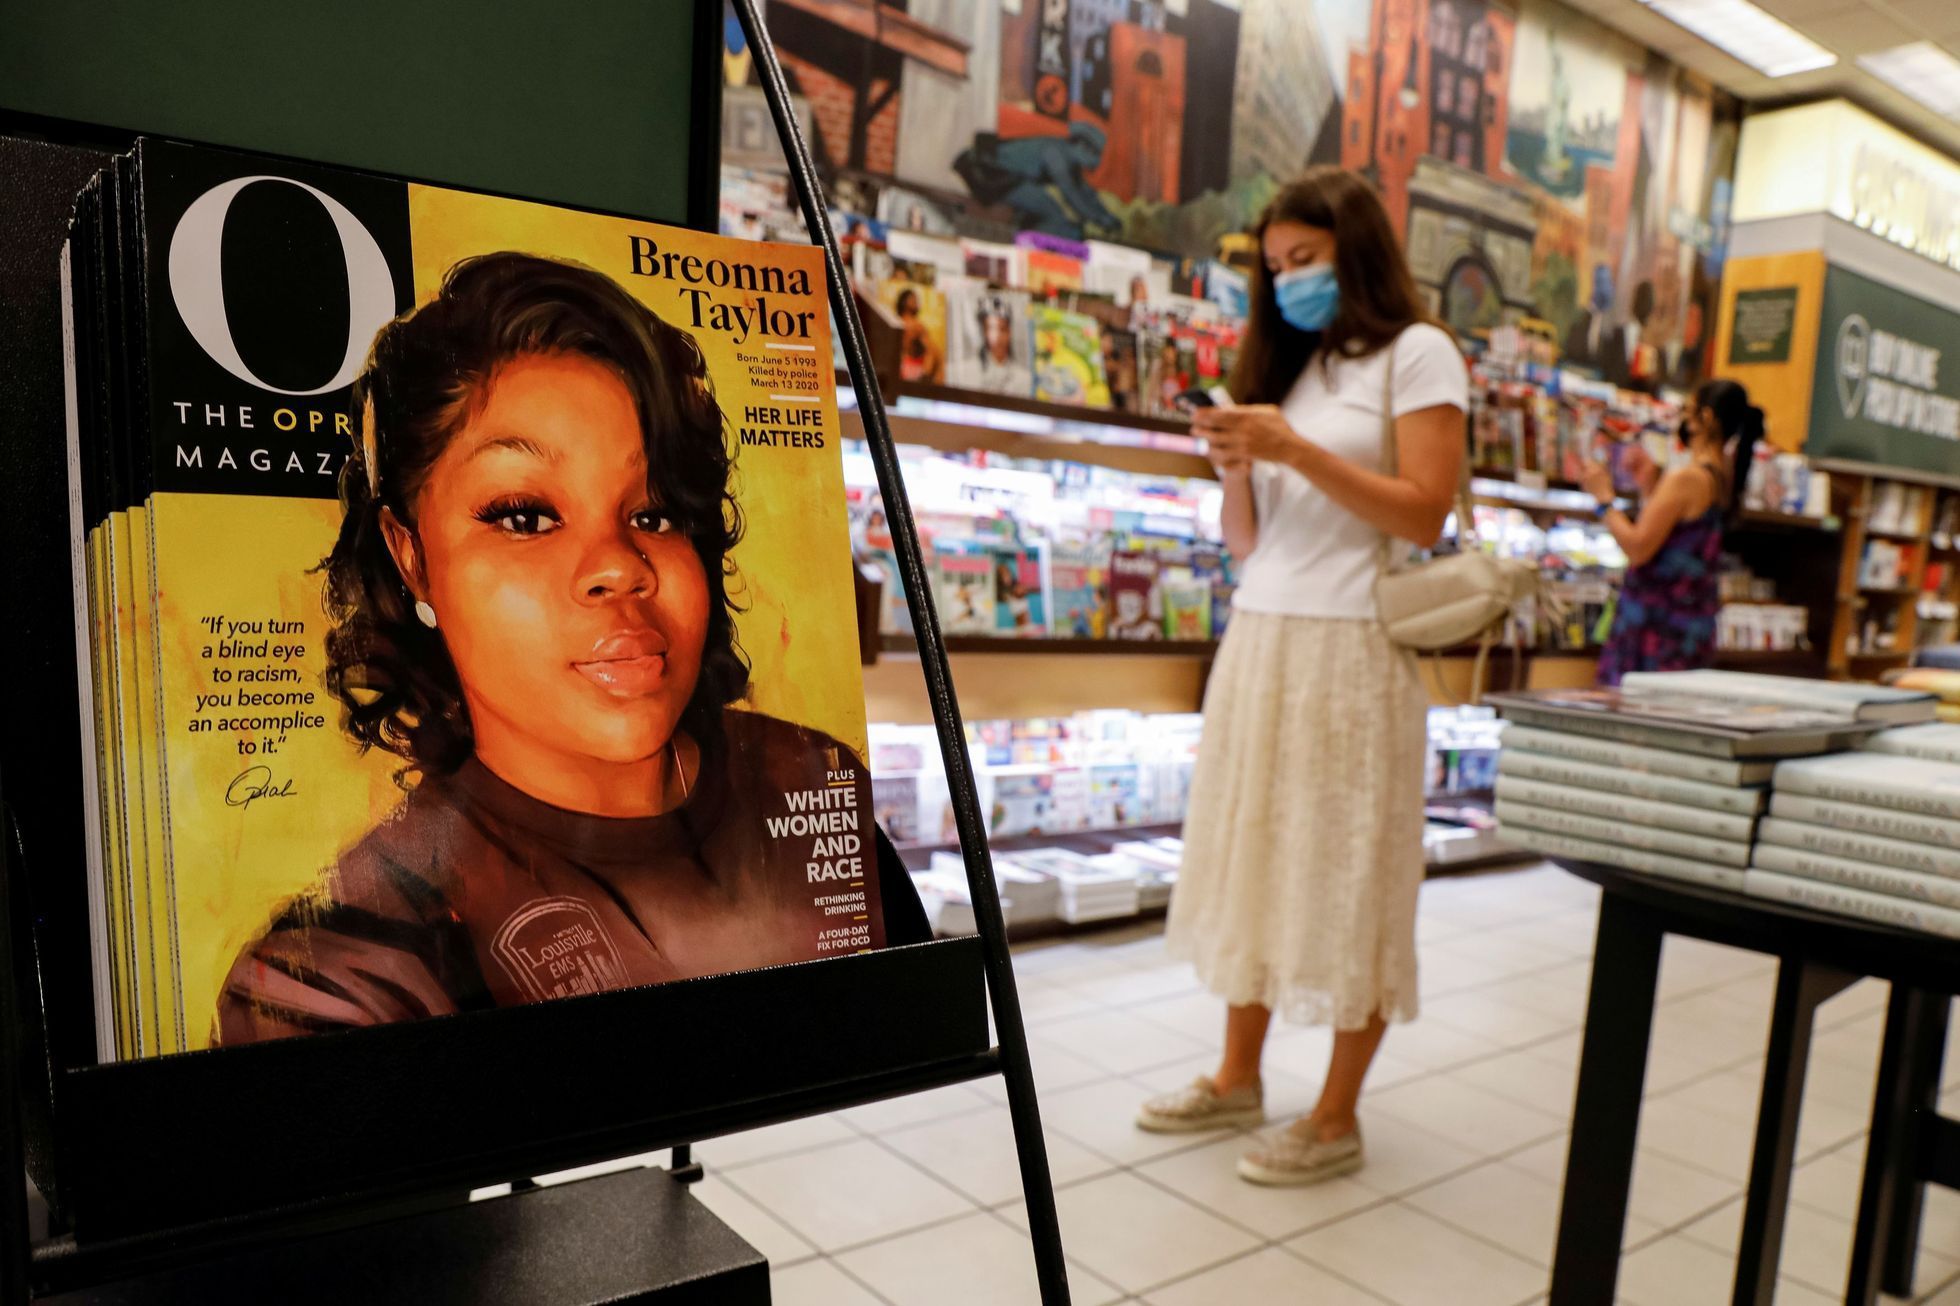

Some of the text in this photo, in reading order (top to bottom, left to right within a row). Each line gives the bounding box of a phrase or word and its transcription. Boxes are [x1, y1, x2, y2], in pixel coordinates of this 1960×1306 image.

[628, 235, 813, 296] Breonna
[168, 174, 396, 396] O
[679, 287, 815, 345] Taylor
[736, 353, 817, 367] Born June 5 1993
[748, 366, 818, 379] Killed by police
[751, 378, 819, 390] March 13 2020
[173, 401, 255, 429] THE
[745, 406, 823, 427] HER LIFE
[740, 428, 825, 448] MATTERS
[228, 619, 262, 639] you
[268, 618, 305, 634] turn
[201, 640, 306, 663] a blind eye
[212, 665, 302, 684] to racism,
[196, 688, 315, 712] you become
[188, 711, 325, 734] an accomplice
[237, 739, 257, 755] to
[827, 769, 855, 780] PLUS
[784, 787, 857, 813] WHITE
[766, 810, 859, 839] WOMEN
[812, 834, 861, 858] AND
[806, 857, 864, 883] RACE
[814, 892, 865, 907] RETHINKING
[825, 902, 867, 916] DRINKING
[817, 935, 871, 951] FIX FOR OCD
[818, 925, 869, 940] A FOUR-DAY
[517, 923, 597, 969] Louisville
[549, 956, 576, 979] EMS
